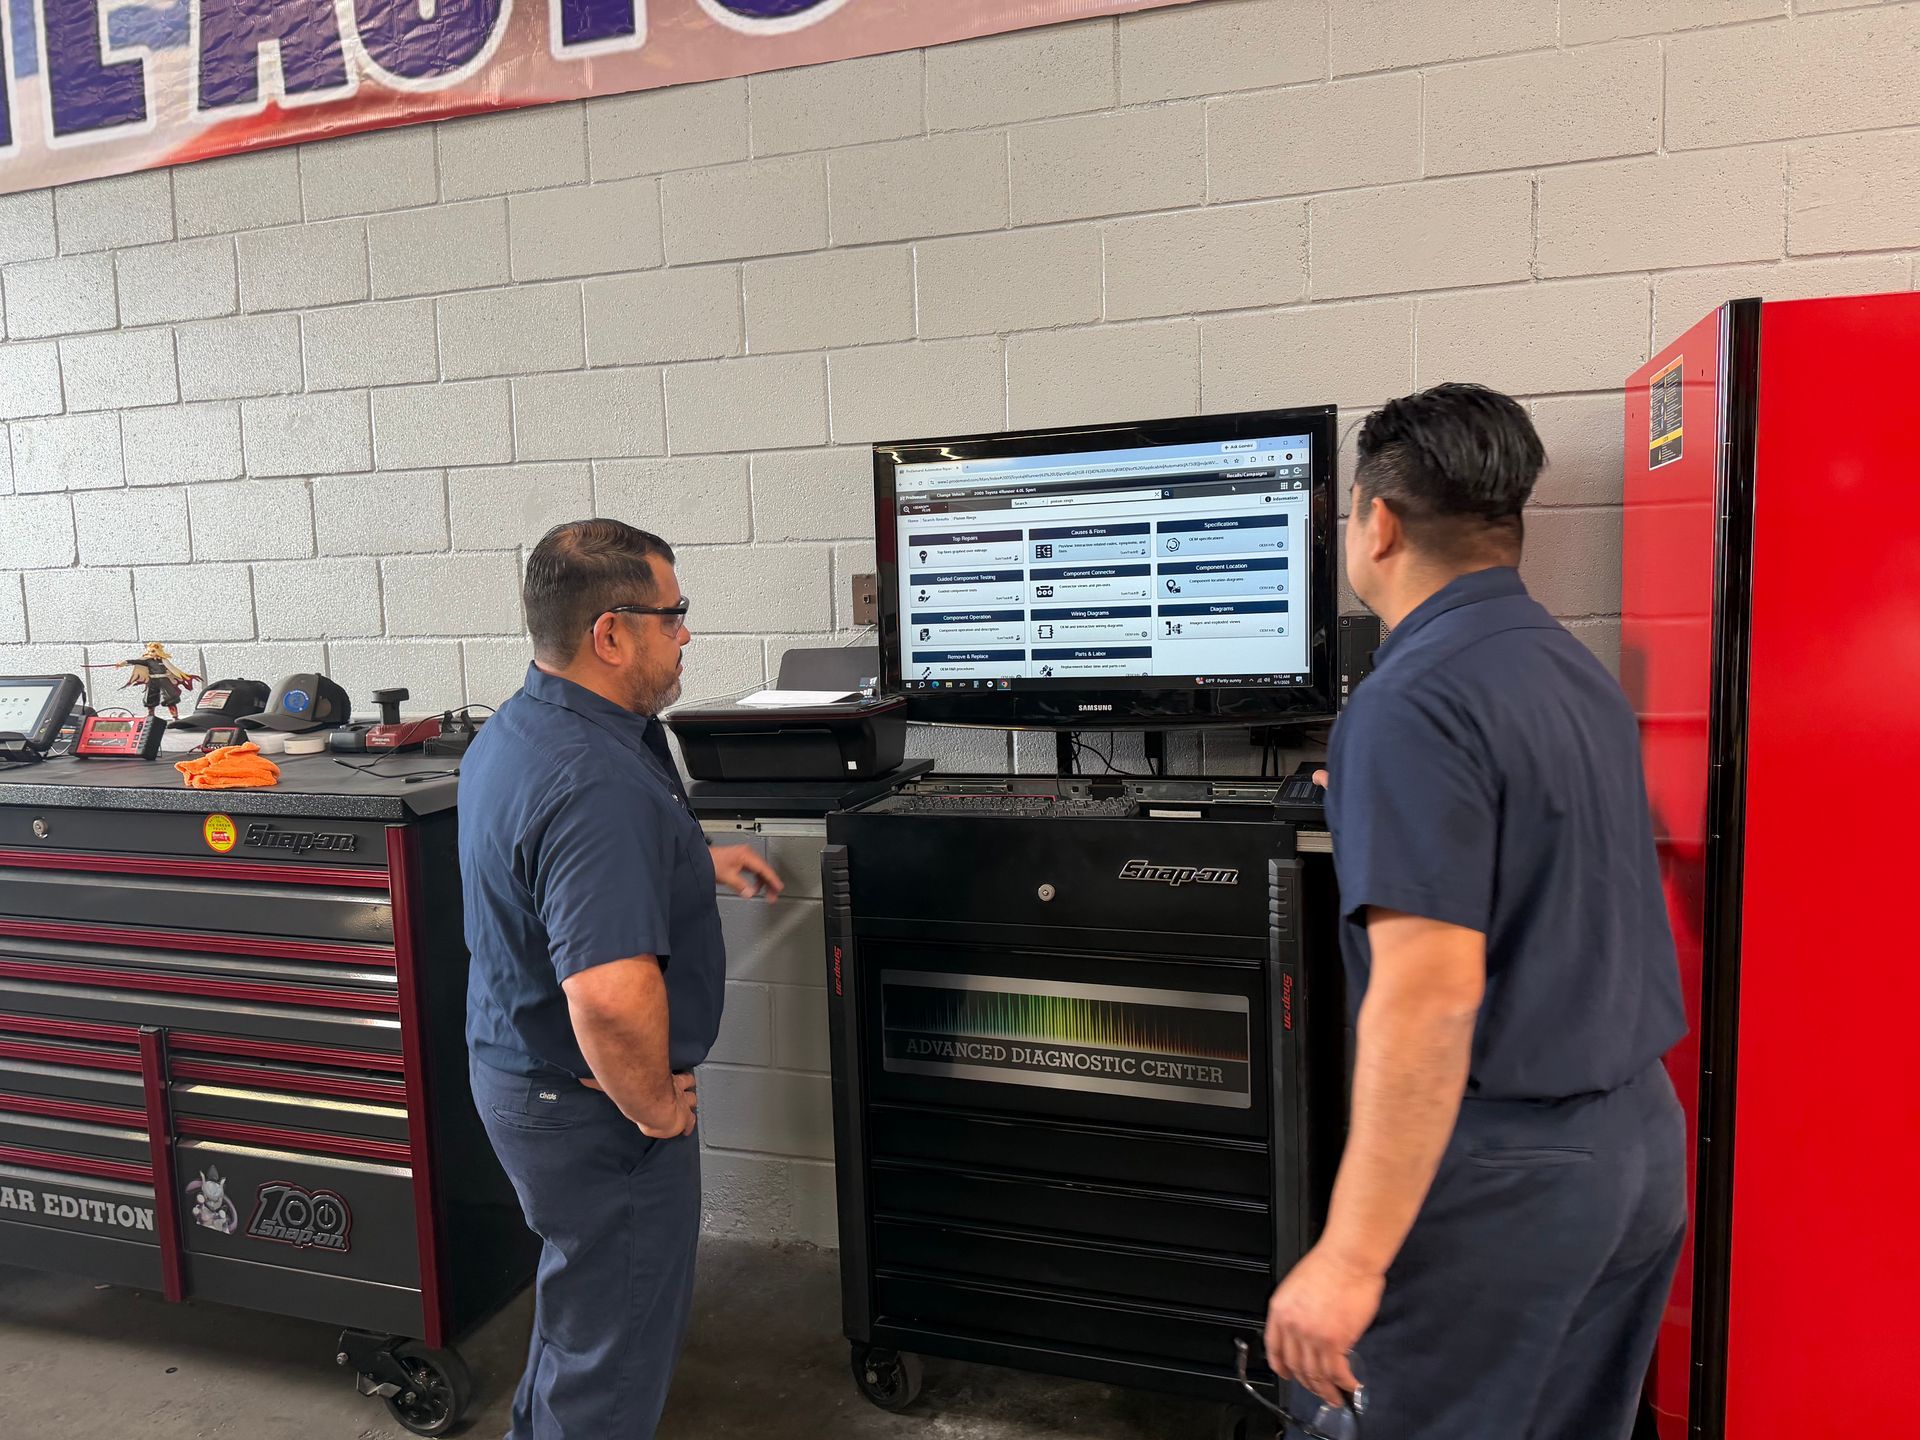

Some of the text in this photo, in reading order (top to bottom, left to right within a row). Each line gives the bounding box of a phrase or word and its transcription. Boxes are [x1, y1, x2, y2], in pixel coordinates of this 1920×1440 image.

[244, 823, 355, 854] Snap-on
[1119, 860, 1239, 886] Snap-on
[907, 1038, 1224, 1084] ADVANCED DIAGNOSTIC CENTER
[42, 1194, 154, 1231] EDITION
[252, 1185, 348, 1229] 100
[250, 1218, 346, 1248] Snap-on
